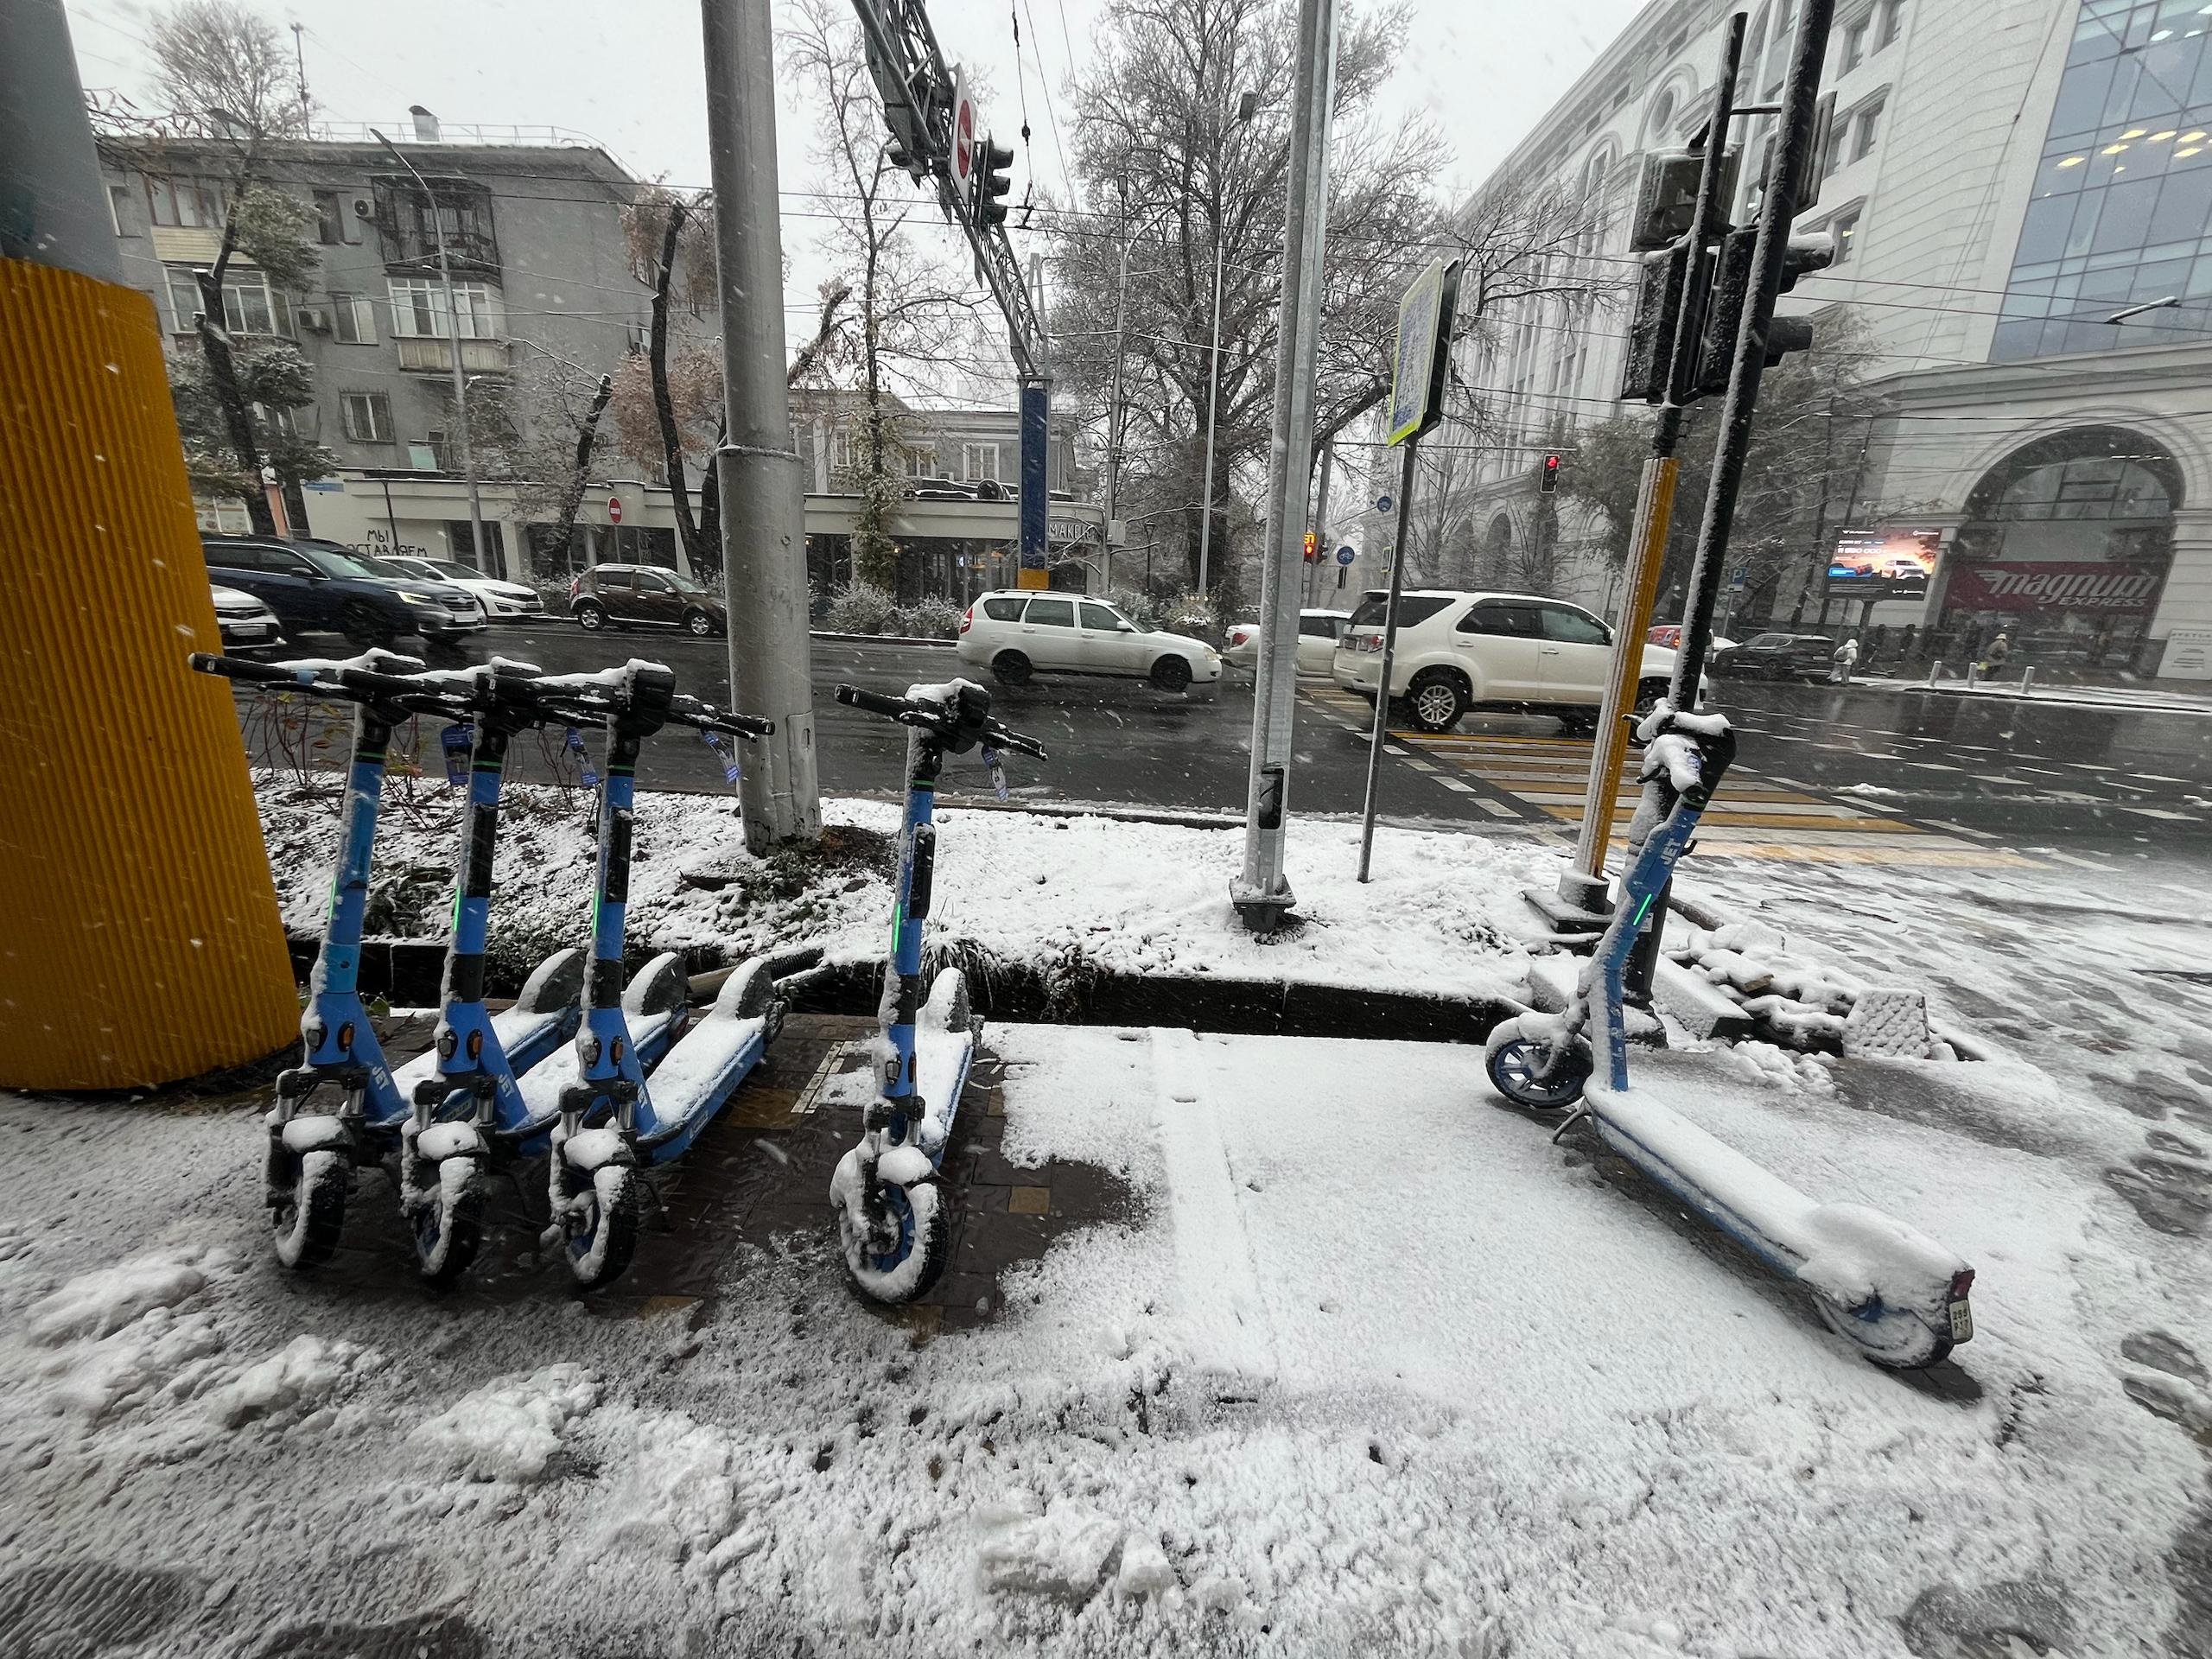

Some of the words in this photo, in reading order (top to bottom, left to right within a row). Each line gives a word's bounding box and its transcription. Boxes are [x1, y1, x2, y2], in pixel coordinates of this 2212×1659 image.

[367, 530, 389, 543] МЫ
[2058, 596, 2148, 607] EXPRESS
[1660, 837, 1681, 865] JET
[372, 1065, 390, 1090] JET
[498, 1073, 515, 1097] JET
